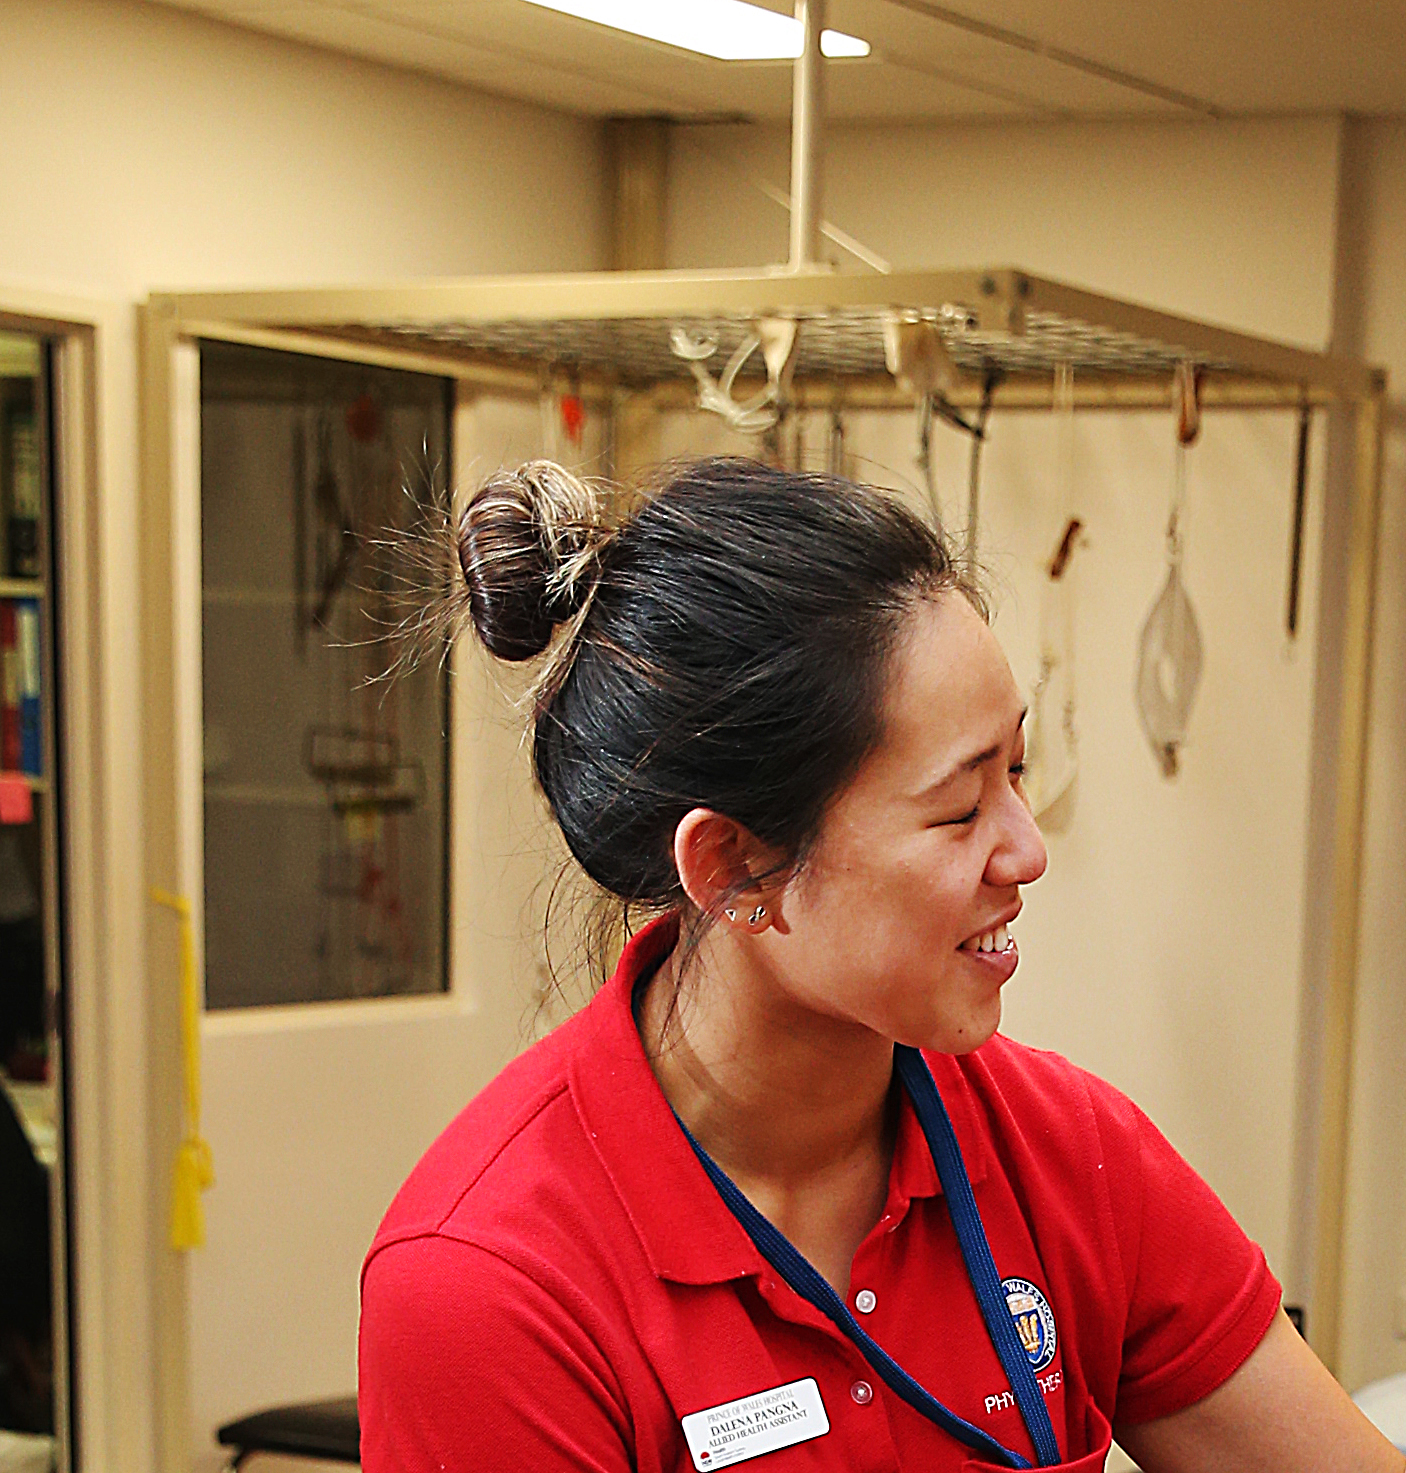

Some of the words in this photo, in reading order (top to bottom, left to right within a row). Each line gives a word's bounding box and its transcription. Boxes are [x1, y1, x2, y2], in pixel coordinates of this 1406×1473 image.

[707, 1408, 731, 1424] PRINCE
[732, 1405, 741, 1415] OF
[742, 1399, 764, 1413] WALES
[764, 1389, 795, 1405] HOSPITAL
[711, 1414, 753, 1437] DALENA
[754, 1400, 799, 1422] PANGNA
[708, 1432, 736, 1448] ALLIED
[737, 1423, 768, 1439] HEALTH
[769, 1409, 808, 1428] ASSISTANT
